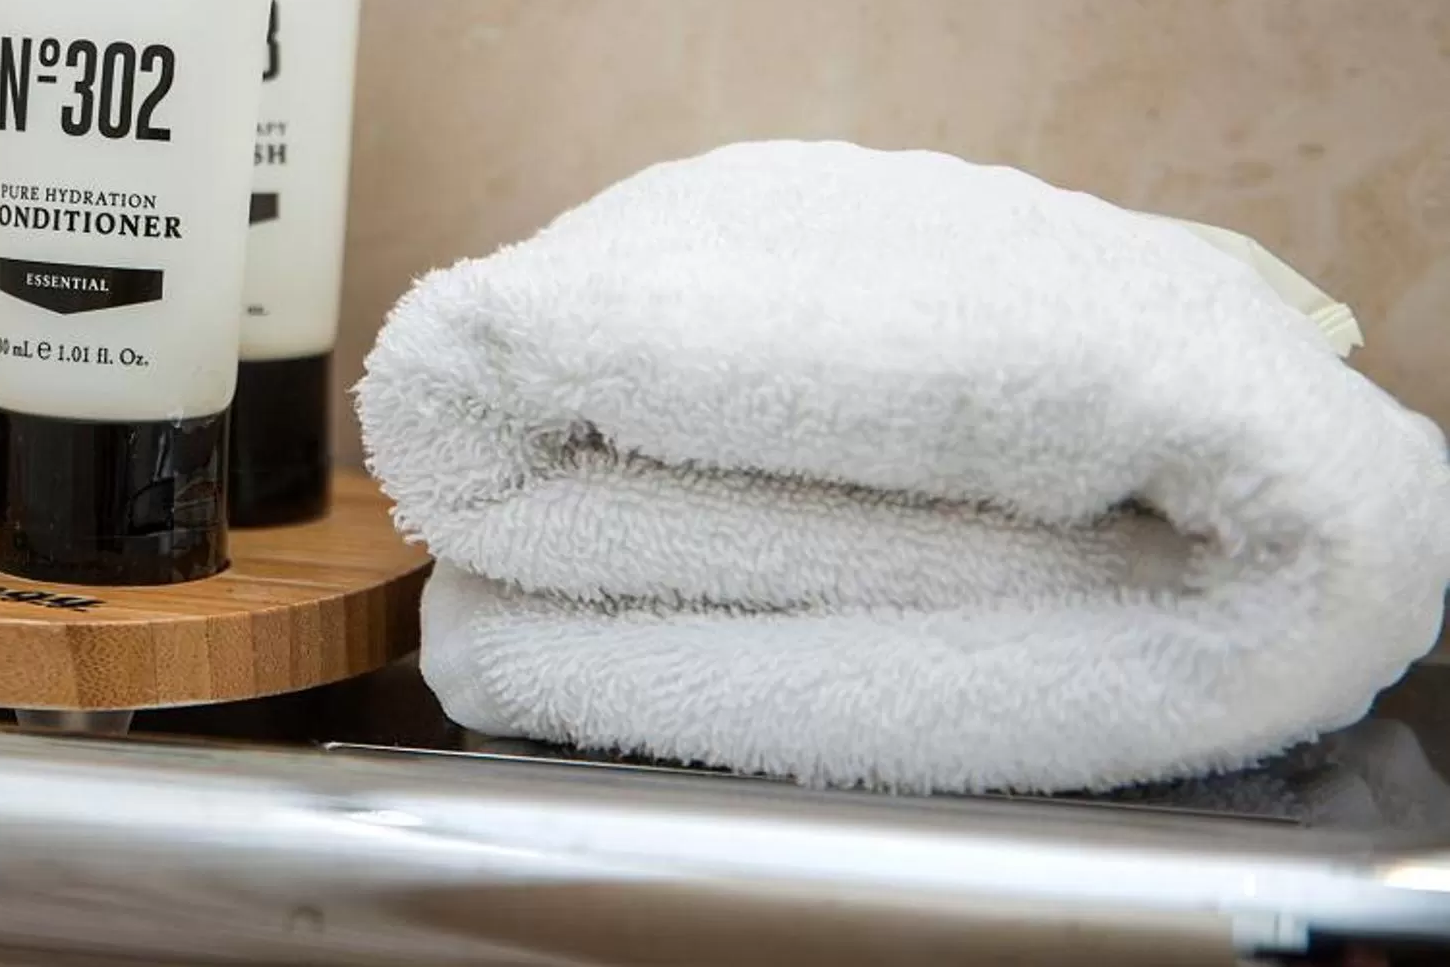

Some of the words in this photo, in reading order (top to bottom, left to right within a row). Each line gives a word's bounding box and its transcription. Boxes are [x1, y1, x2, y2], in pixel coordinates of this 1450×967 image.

[1, 184, 40, 201] PURE
[45, 188, 157, 210] HYDRATION
[26, 273, 109, 293] ESSENTIAL
[12, 341, 33, 358] mL
[57, 345, 90, 363] 1.01
[119, 348, 149, 367] Oz.
